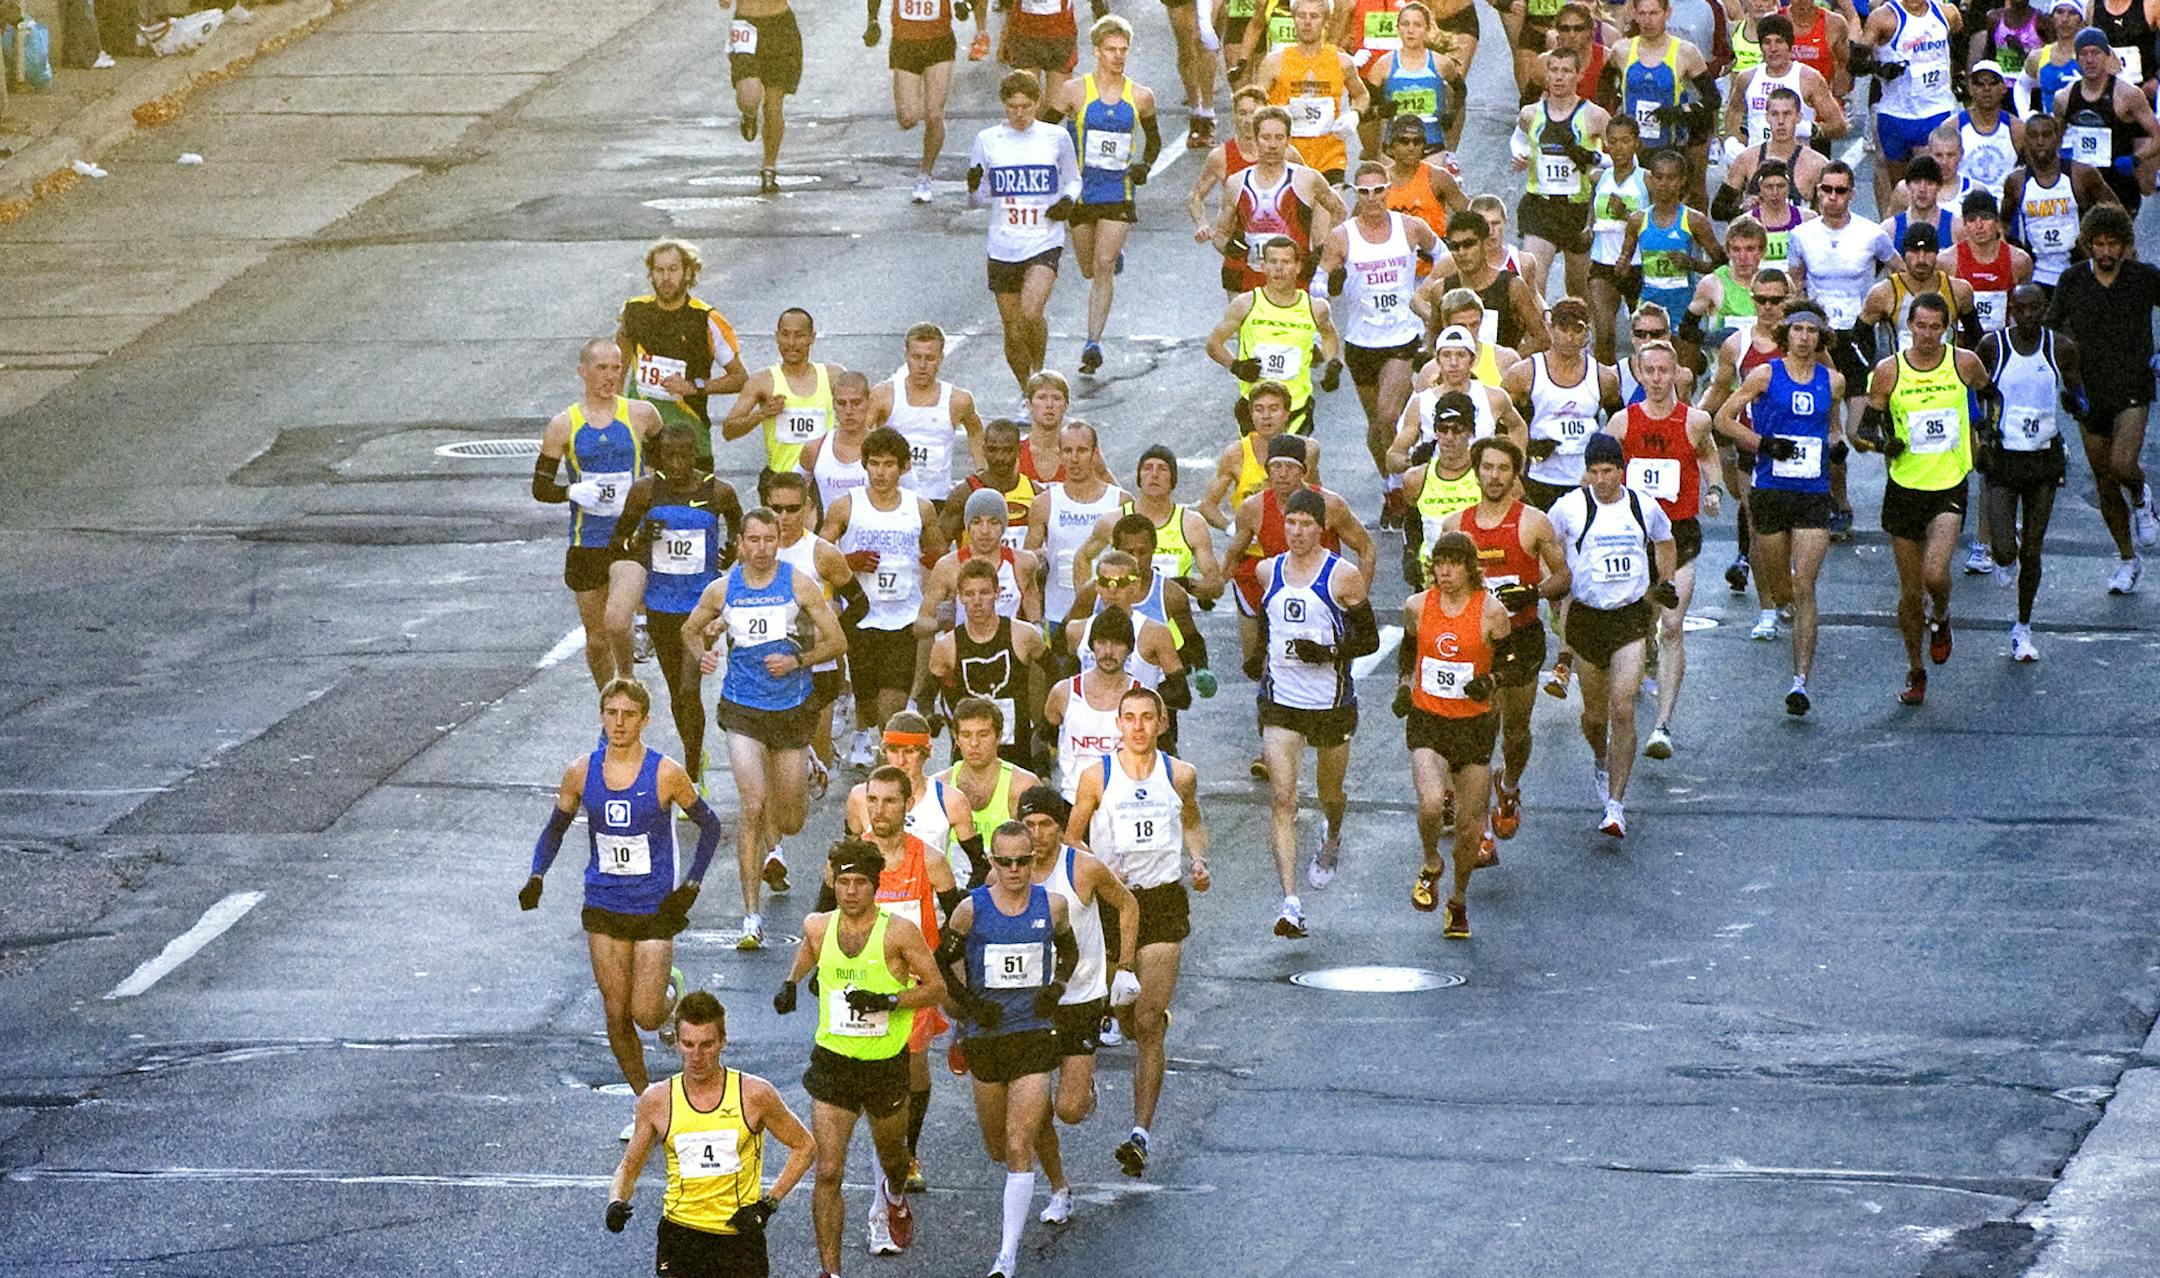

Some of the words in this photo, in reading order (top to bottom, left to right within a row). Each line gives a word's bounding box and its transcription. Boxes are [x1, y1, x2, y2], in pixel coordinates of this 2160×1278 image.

[905, 1, 933, 16] 818
[1922, 70, 1940, 84] 122
[1546, 165, 1570, 178] 118
[995, 169, 1050, 193] DRAKE
[2025, 197, 2070, 218] NAVY
[1009, 208, 1038, 225] 311
[2044, 229, 2060, 242] 42
[1367, 271, 1398, 284] Elite
[1373, 294, 1397, 309] 108
[1251, 318, 1312, 331] BROOKS
[1269, 354, 1285, 369] 30
[789, 418, 814, 432] 106
[1561, 420, 1585, 436] 105
[1643, 468, 1660, 485] 91
[666, 539, 692, 555] 102
[1605, 557, 1631, 573] 110
[878, 573, 897, 588] 57
[748, 619, 767, 635] 20
[1437, 670, 1455, 686] 53
[1072, 736, 1111, 750] NRC
[1134, 820, 1154, 838] 18
[613, 847, 630, 863] 10
[1004, 956, 1024, 973] 51
[703, 1145, 714, 1161] 4
